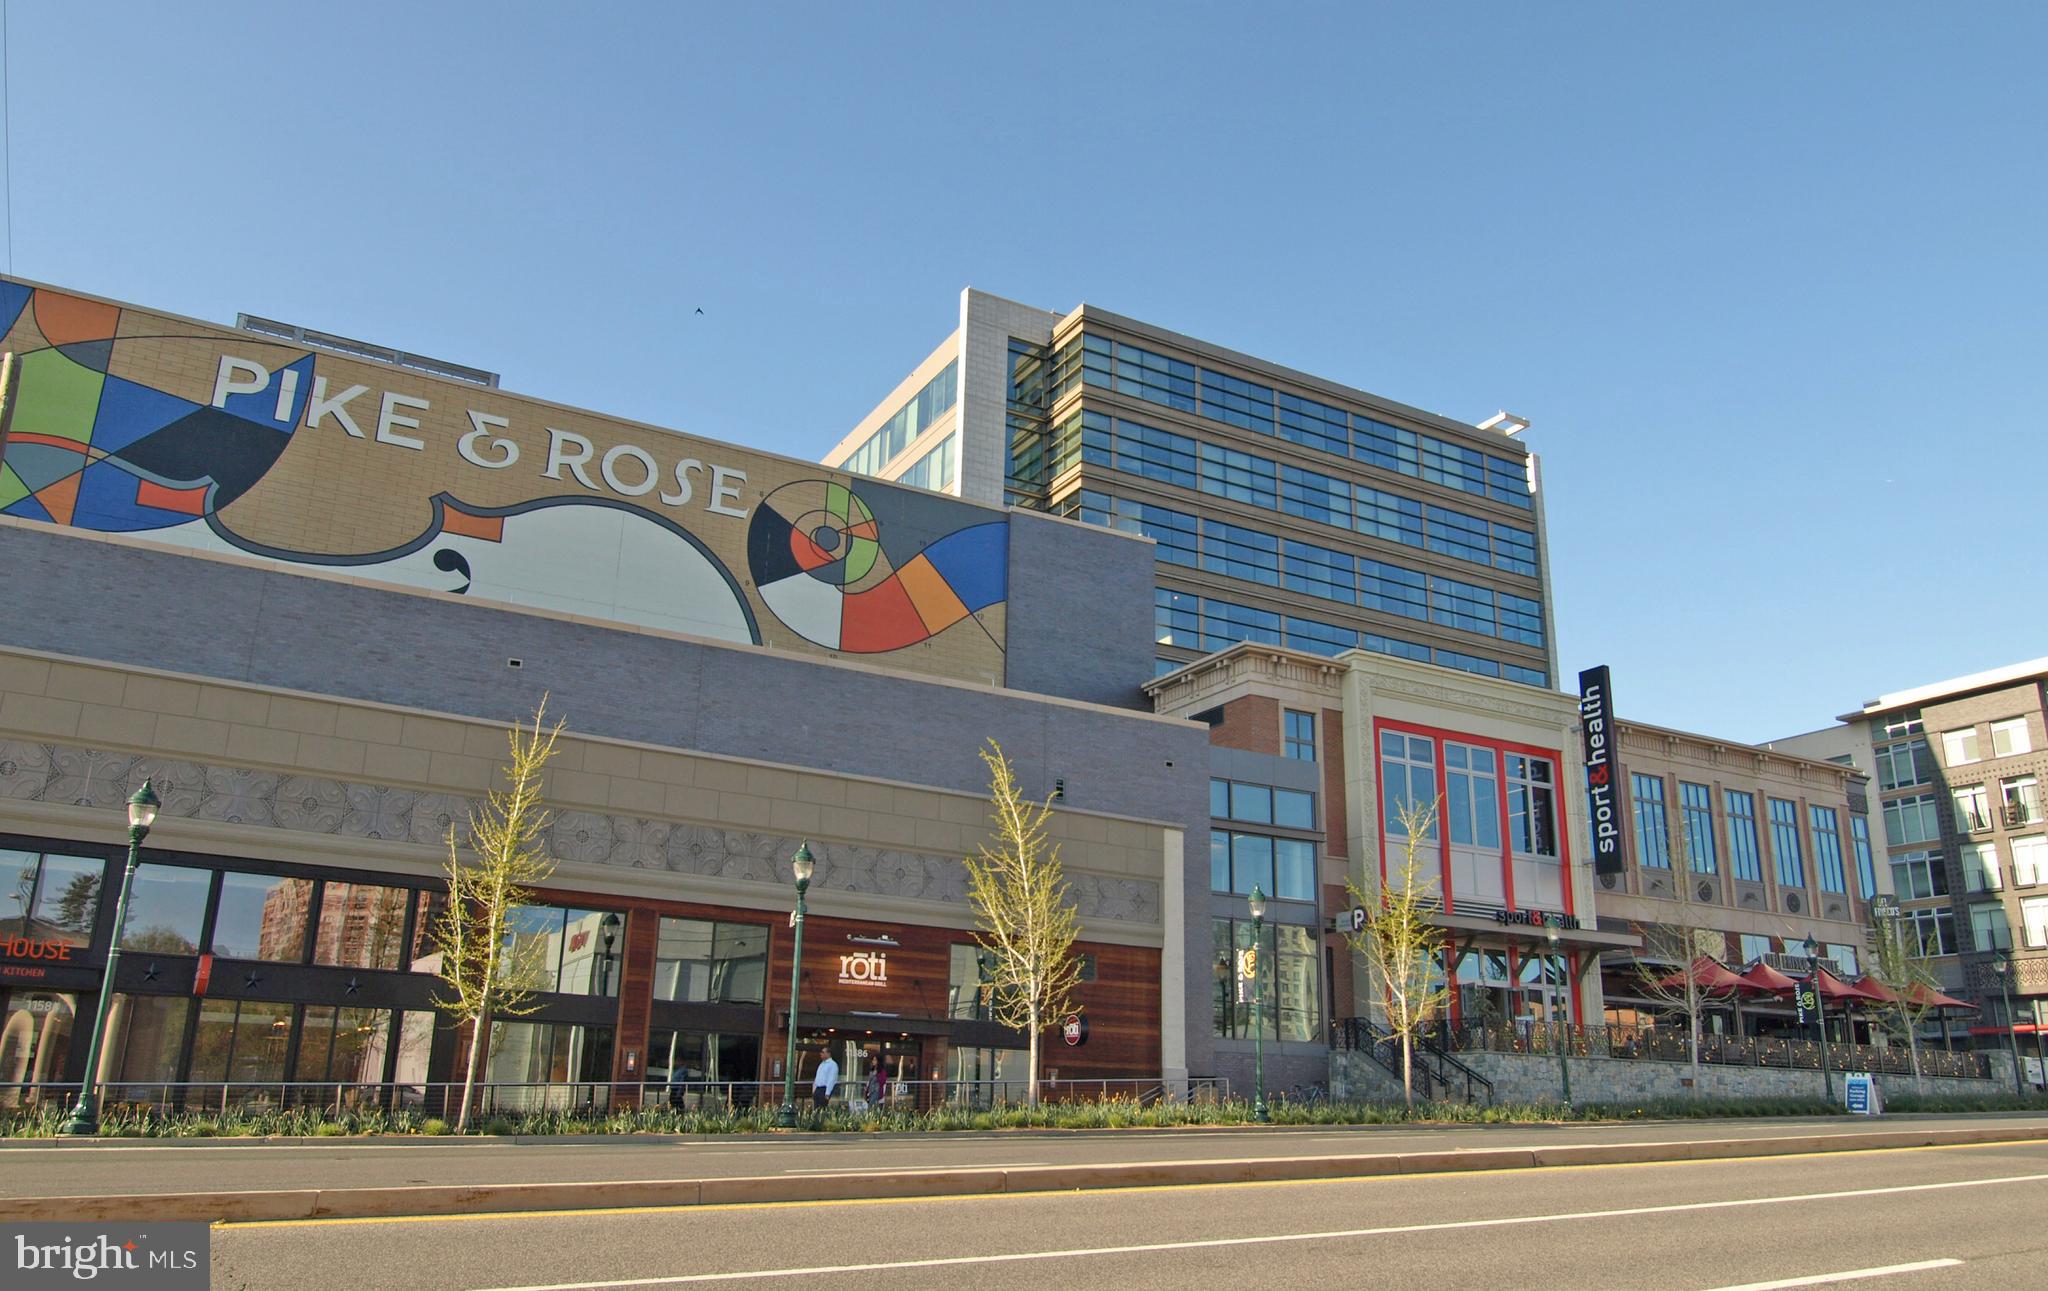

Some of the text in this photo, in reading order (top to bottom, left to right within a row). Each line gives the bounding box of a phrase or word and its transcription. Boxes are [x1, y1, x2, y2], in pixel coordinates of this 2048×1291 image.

[211, 355, 750, 519] PIKE & ROSE
[1582, 684, 1618, 853] sport&health
[1354, 909, 1364, 929] P
[1497, 909, 1580, 930] sport&halth
[0, 931, 74, 960] HOUSE
[3, 966, 46, 977] KITCHEN
